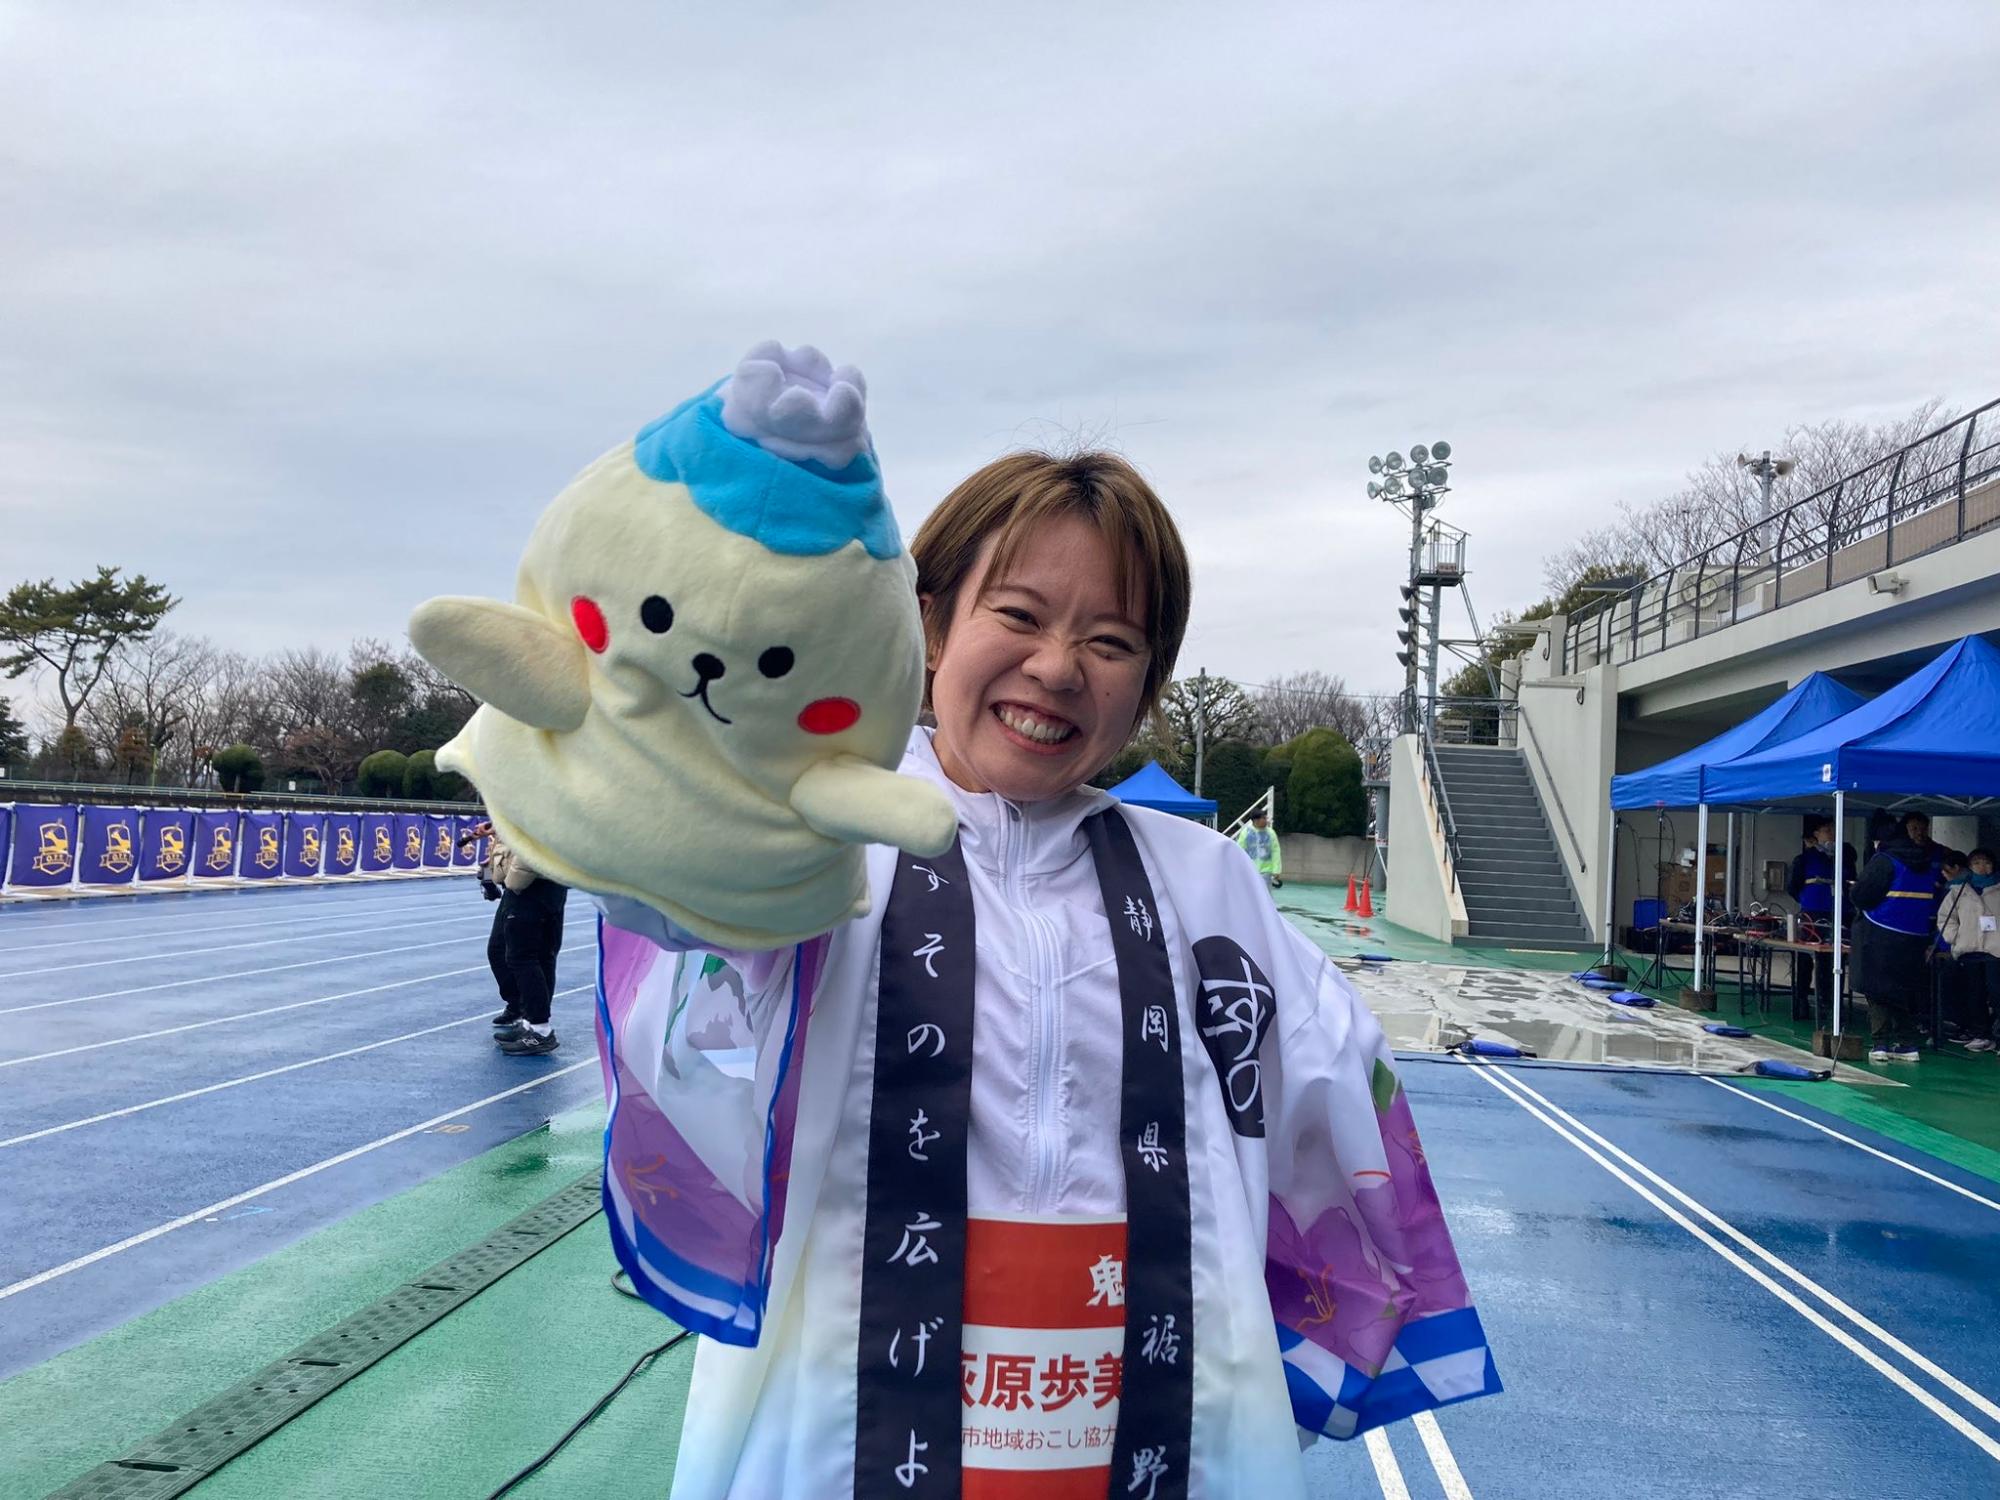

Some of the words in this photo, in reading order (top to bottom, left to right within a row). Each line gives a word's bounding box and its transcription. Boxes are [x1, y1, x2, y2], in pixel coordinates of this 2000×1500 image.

[886, 864, 950, 1489] すそのを広げよ
[1086, 1254, 1125, 1307] 鬼
